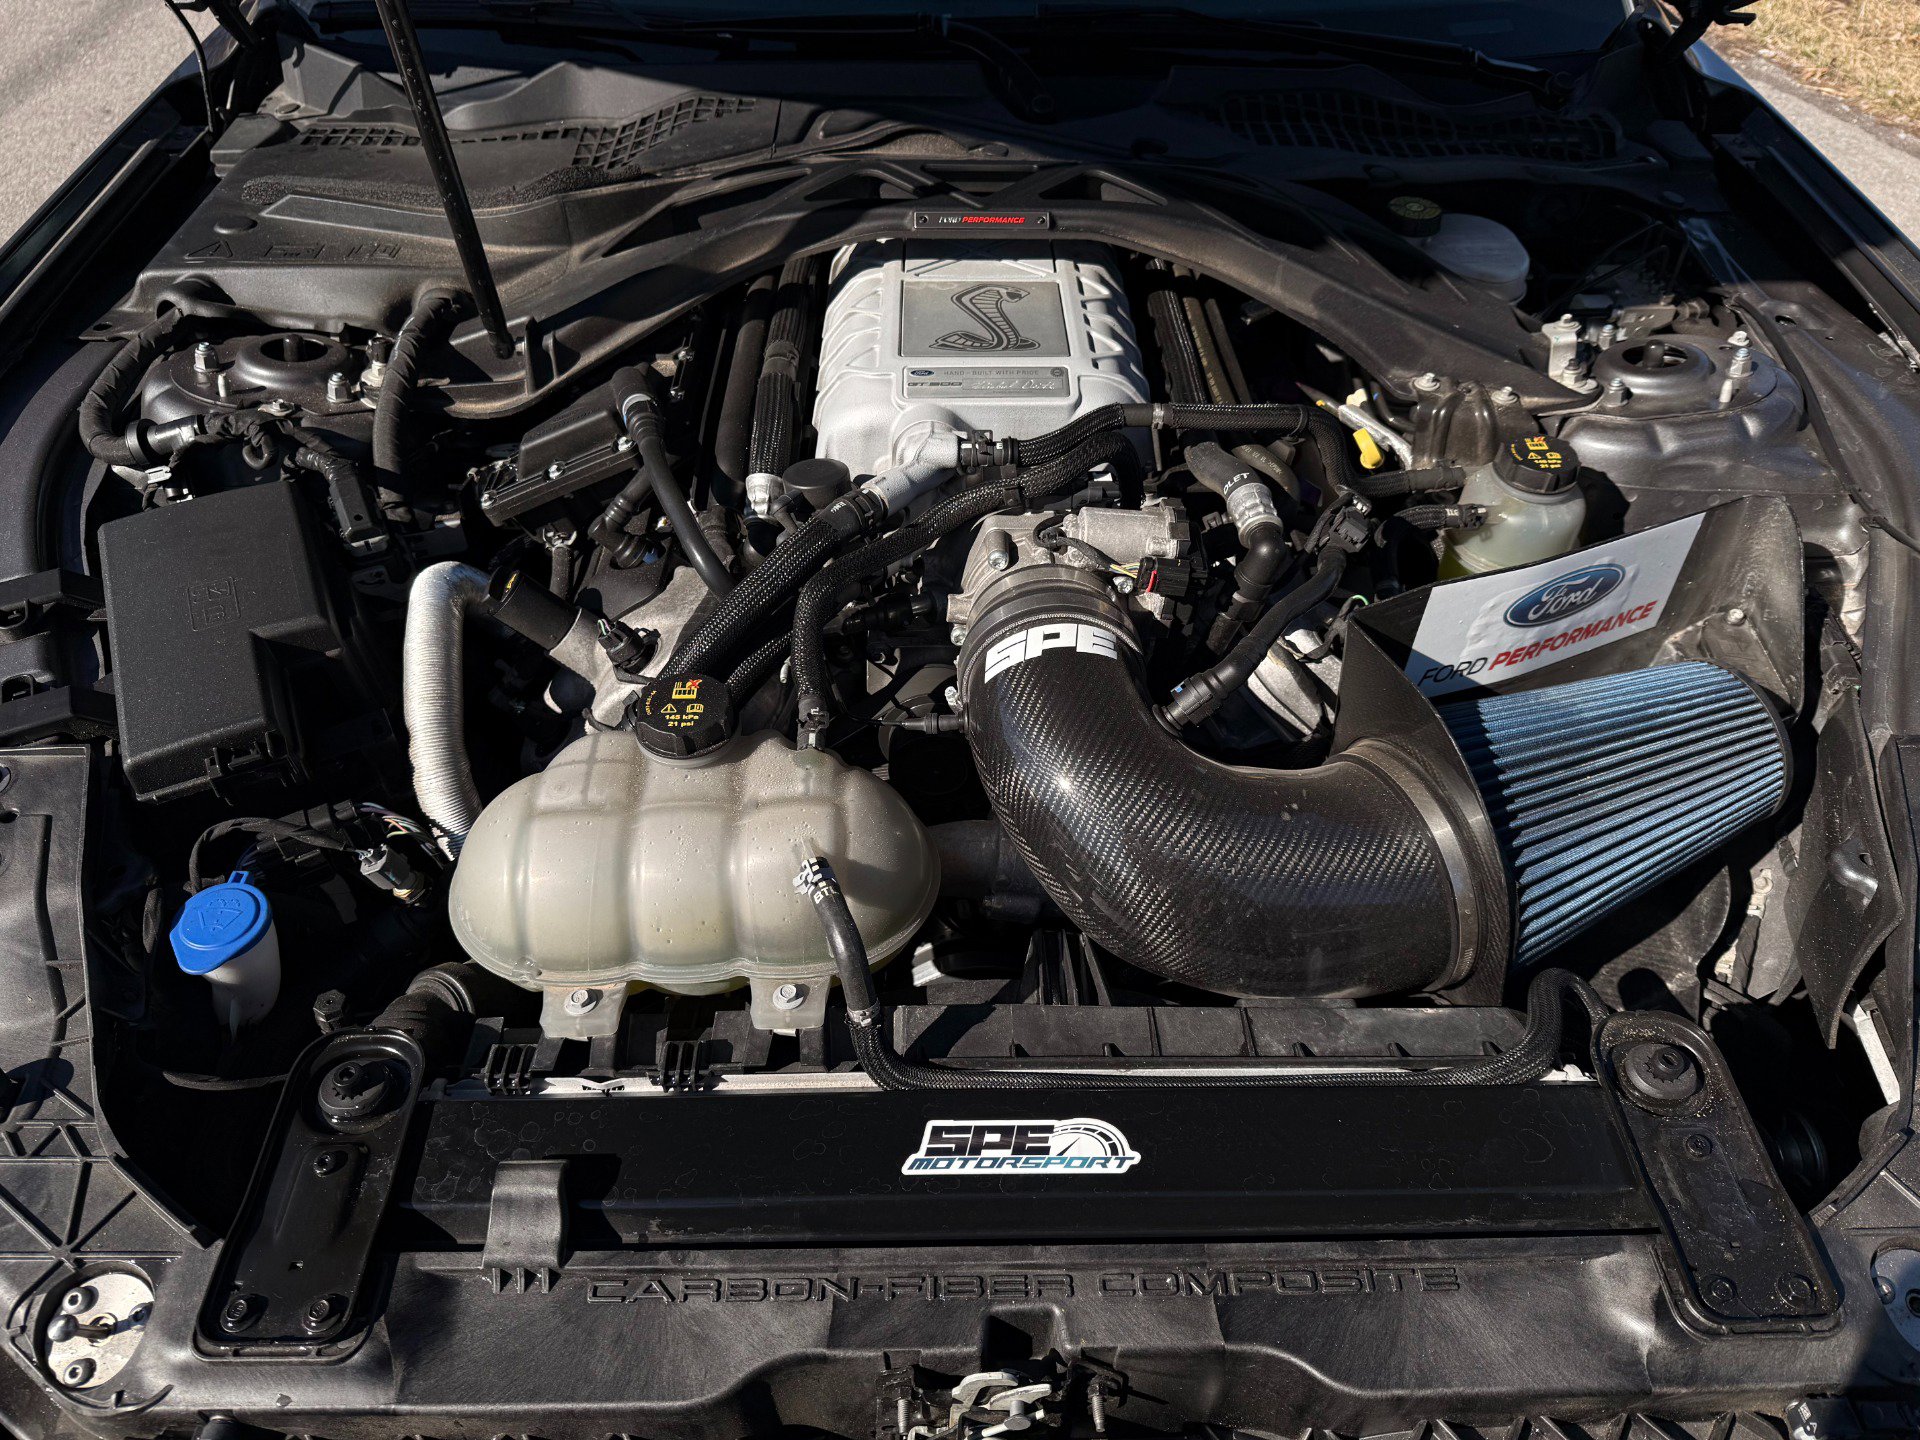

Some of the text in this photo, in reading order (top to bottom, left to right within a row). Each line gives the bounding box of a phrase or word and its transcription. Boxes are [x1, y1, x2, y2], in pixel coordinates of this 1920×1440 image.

[961, 216, 1025, 224] PERFORMANCE
[1528, 575, 1604, 621] Ford
[984, 623, 1118, 684] SPE
[1417, 600, 1658, 687] FORD PERFORMANCE
[924, 1124, 1055, 1157] SPE
[907, 1156, 1137, 1171] MOTORSPORT
[586, 1267, 1461, 1304] CARBON-FIBER COMPOSITE
